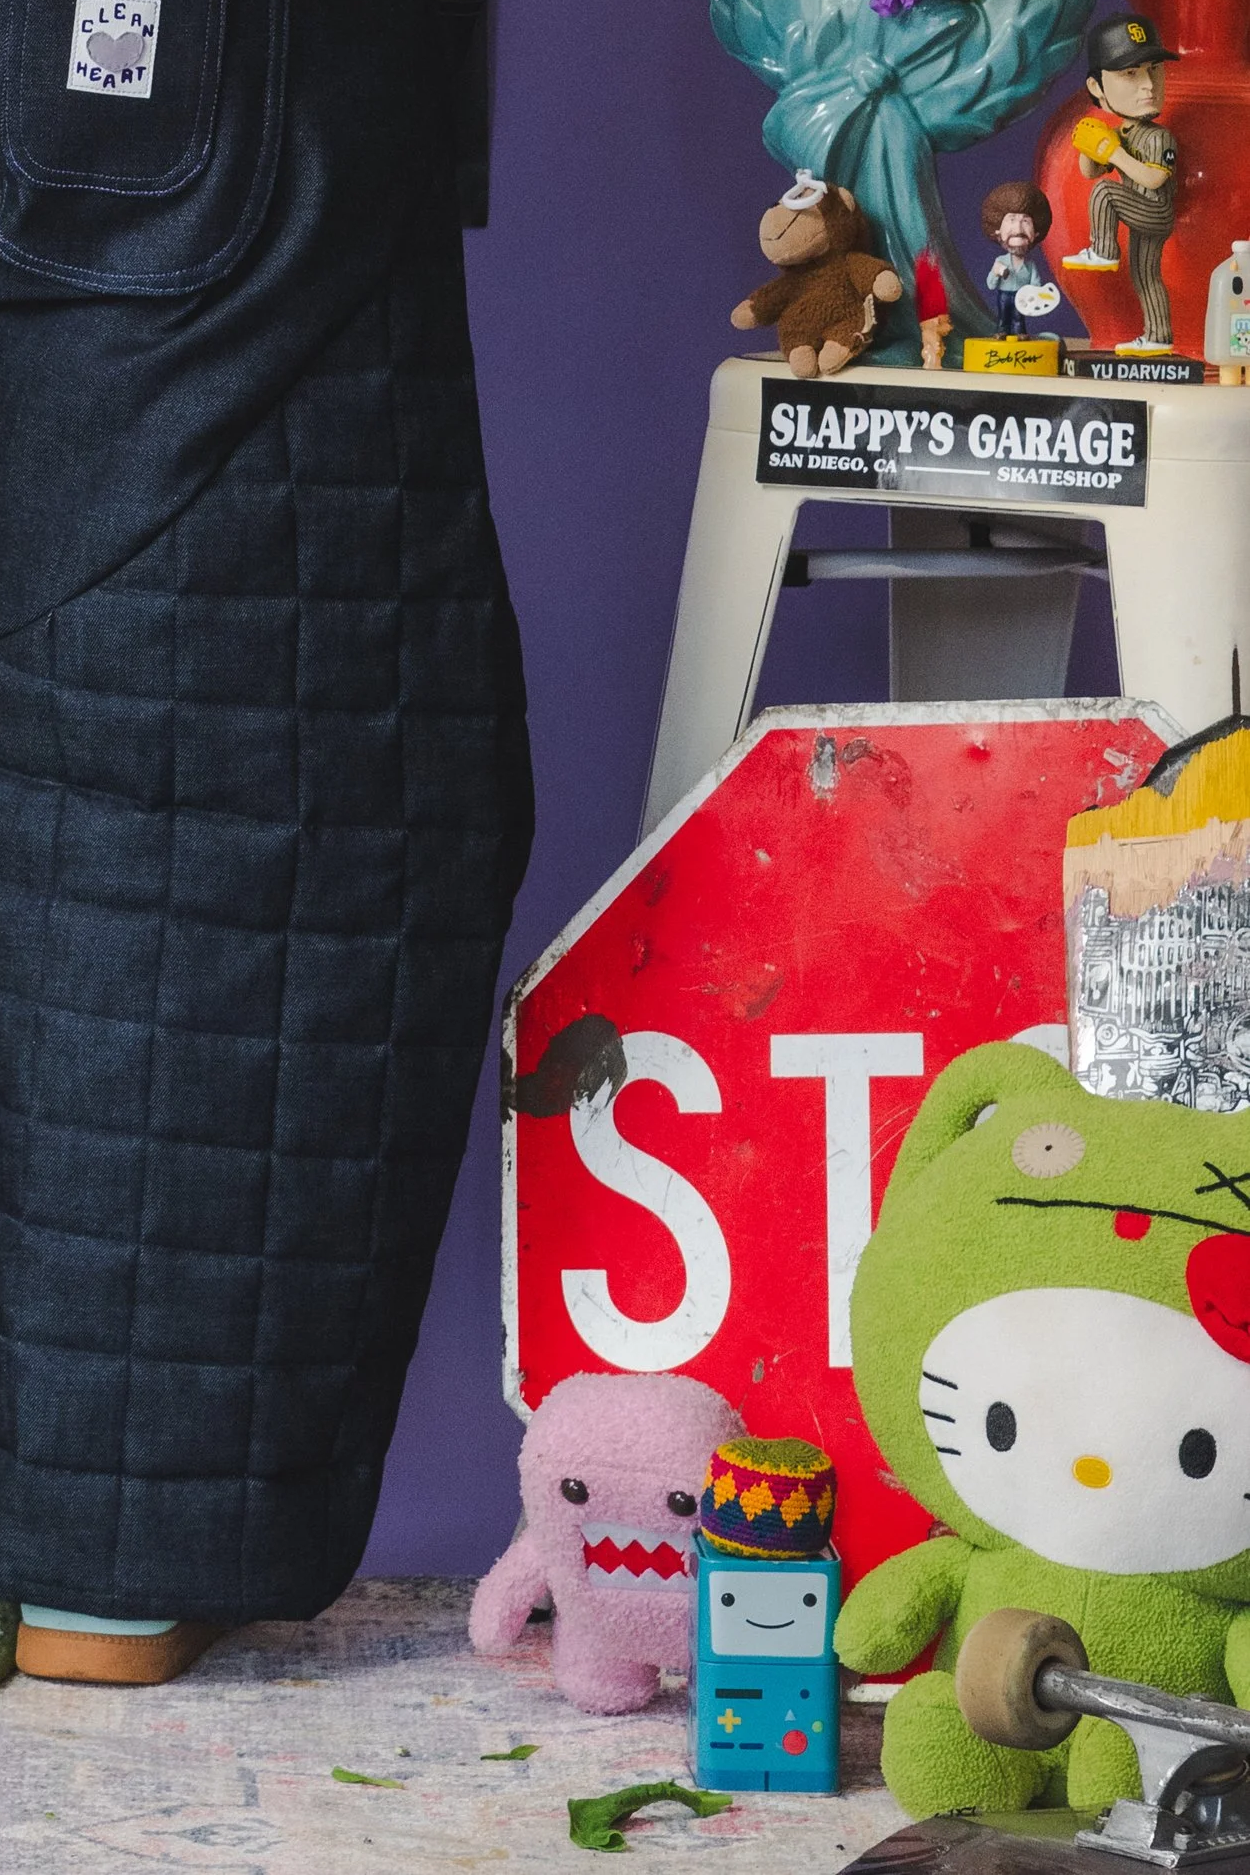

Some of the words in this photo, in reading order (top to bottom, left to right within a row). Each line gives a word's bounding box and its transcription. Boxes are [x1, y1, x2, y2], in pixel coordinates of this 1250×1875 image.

[81, 3, 154, 37] CLEAN
[76, 61, 147, 88] HEART
[984, 350, 1014, 368] Bob
[1014, 351, 1044, 369] Ross
[1091, 363, 1113, 379] YU
[1117, 364, 1190, 380] DARVISH
[769, 403, 954, 456] SLAPPY'S
[968, 414, 1136, 467] GARAGE
[769, 452, 802, 468] SAN
[808, 455, 869, 474] DIEGO,
[873, 458, 897, 473] CA
[997, 466, 1122, 490] SKATESHOP
